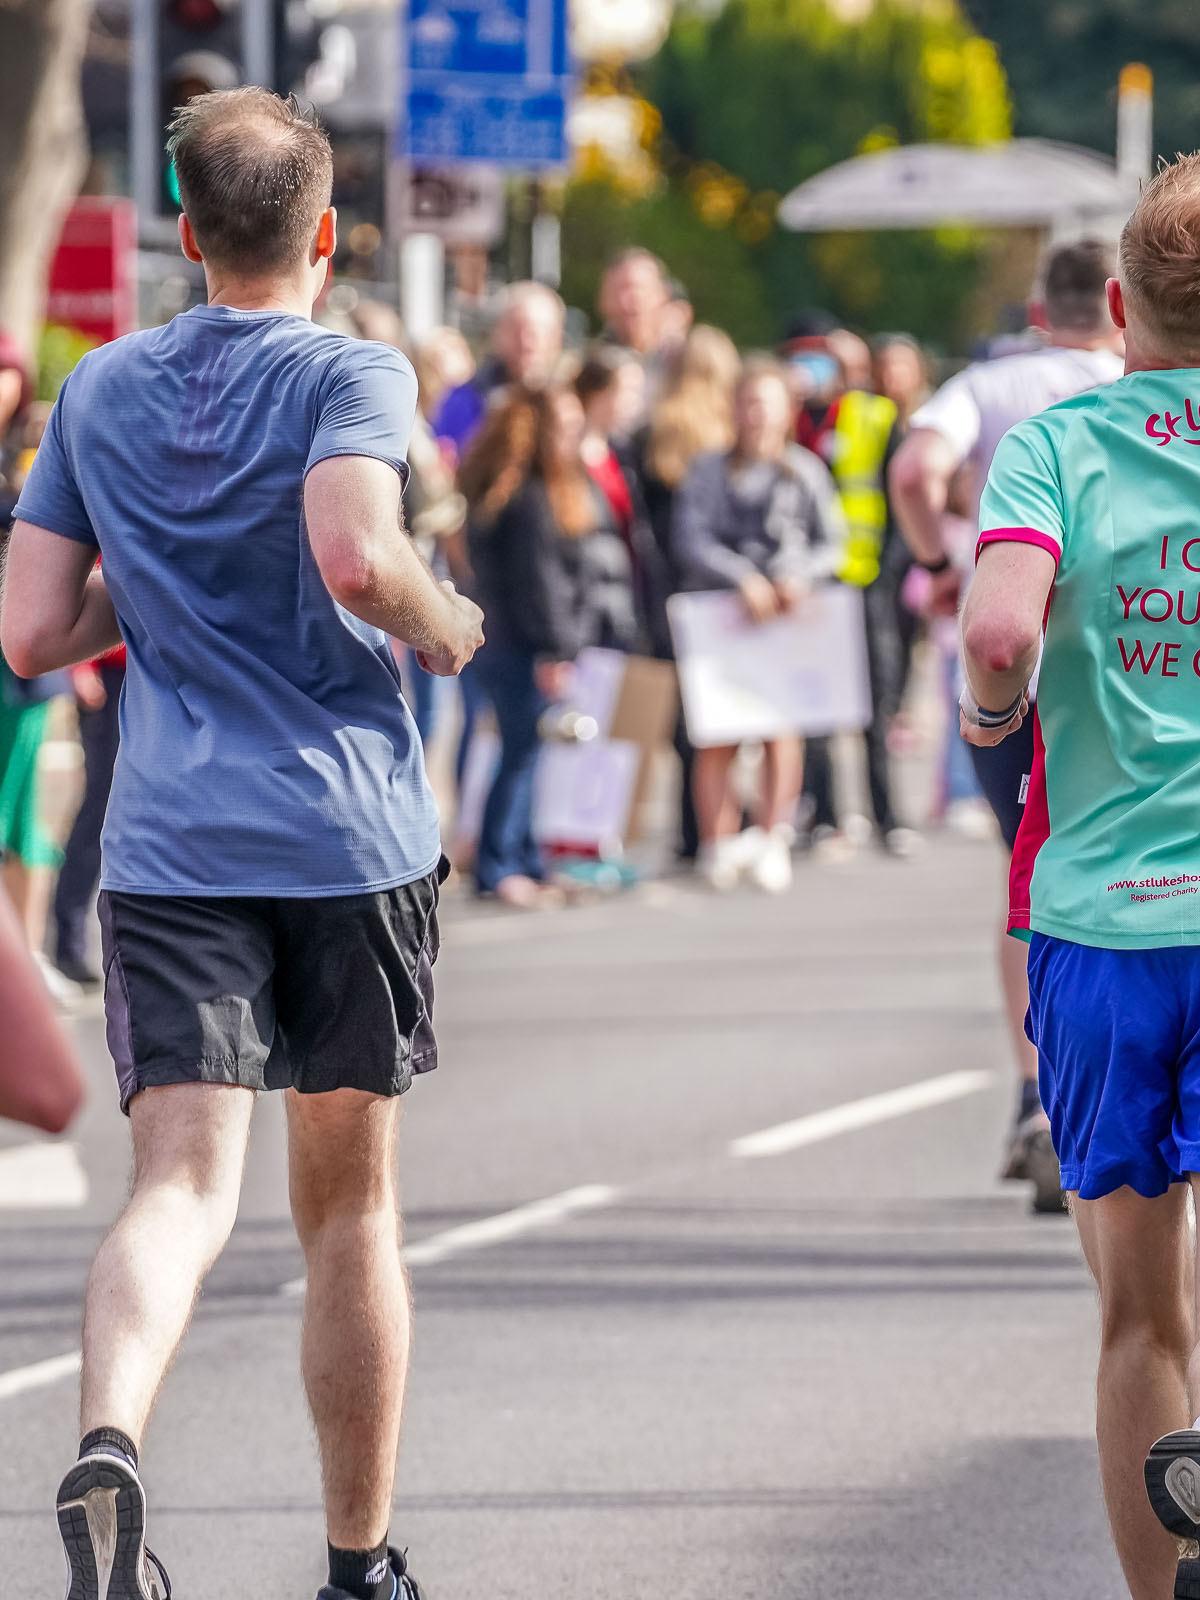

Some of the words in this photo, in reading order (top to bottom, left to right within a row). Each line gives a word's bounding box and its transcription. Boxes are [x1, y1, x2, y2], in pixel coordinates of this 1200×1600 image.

[1145, 411, 1183, 446] St
[1160, 535, 1169, 570] I
[1117, 637, 1182, 678] WE
[1130, 891, 1171, 904] Registered
[1172, 886, 1199, 897] Charity
